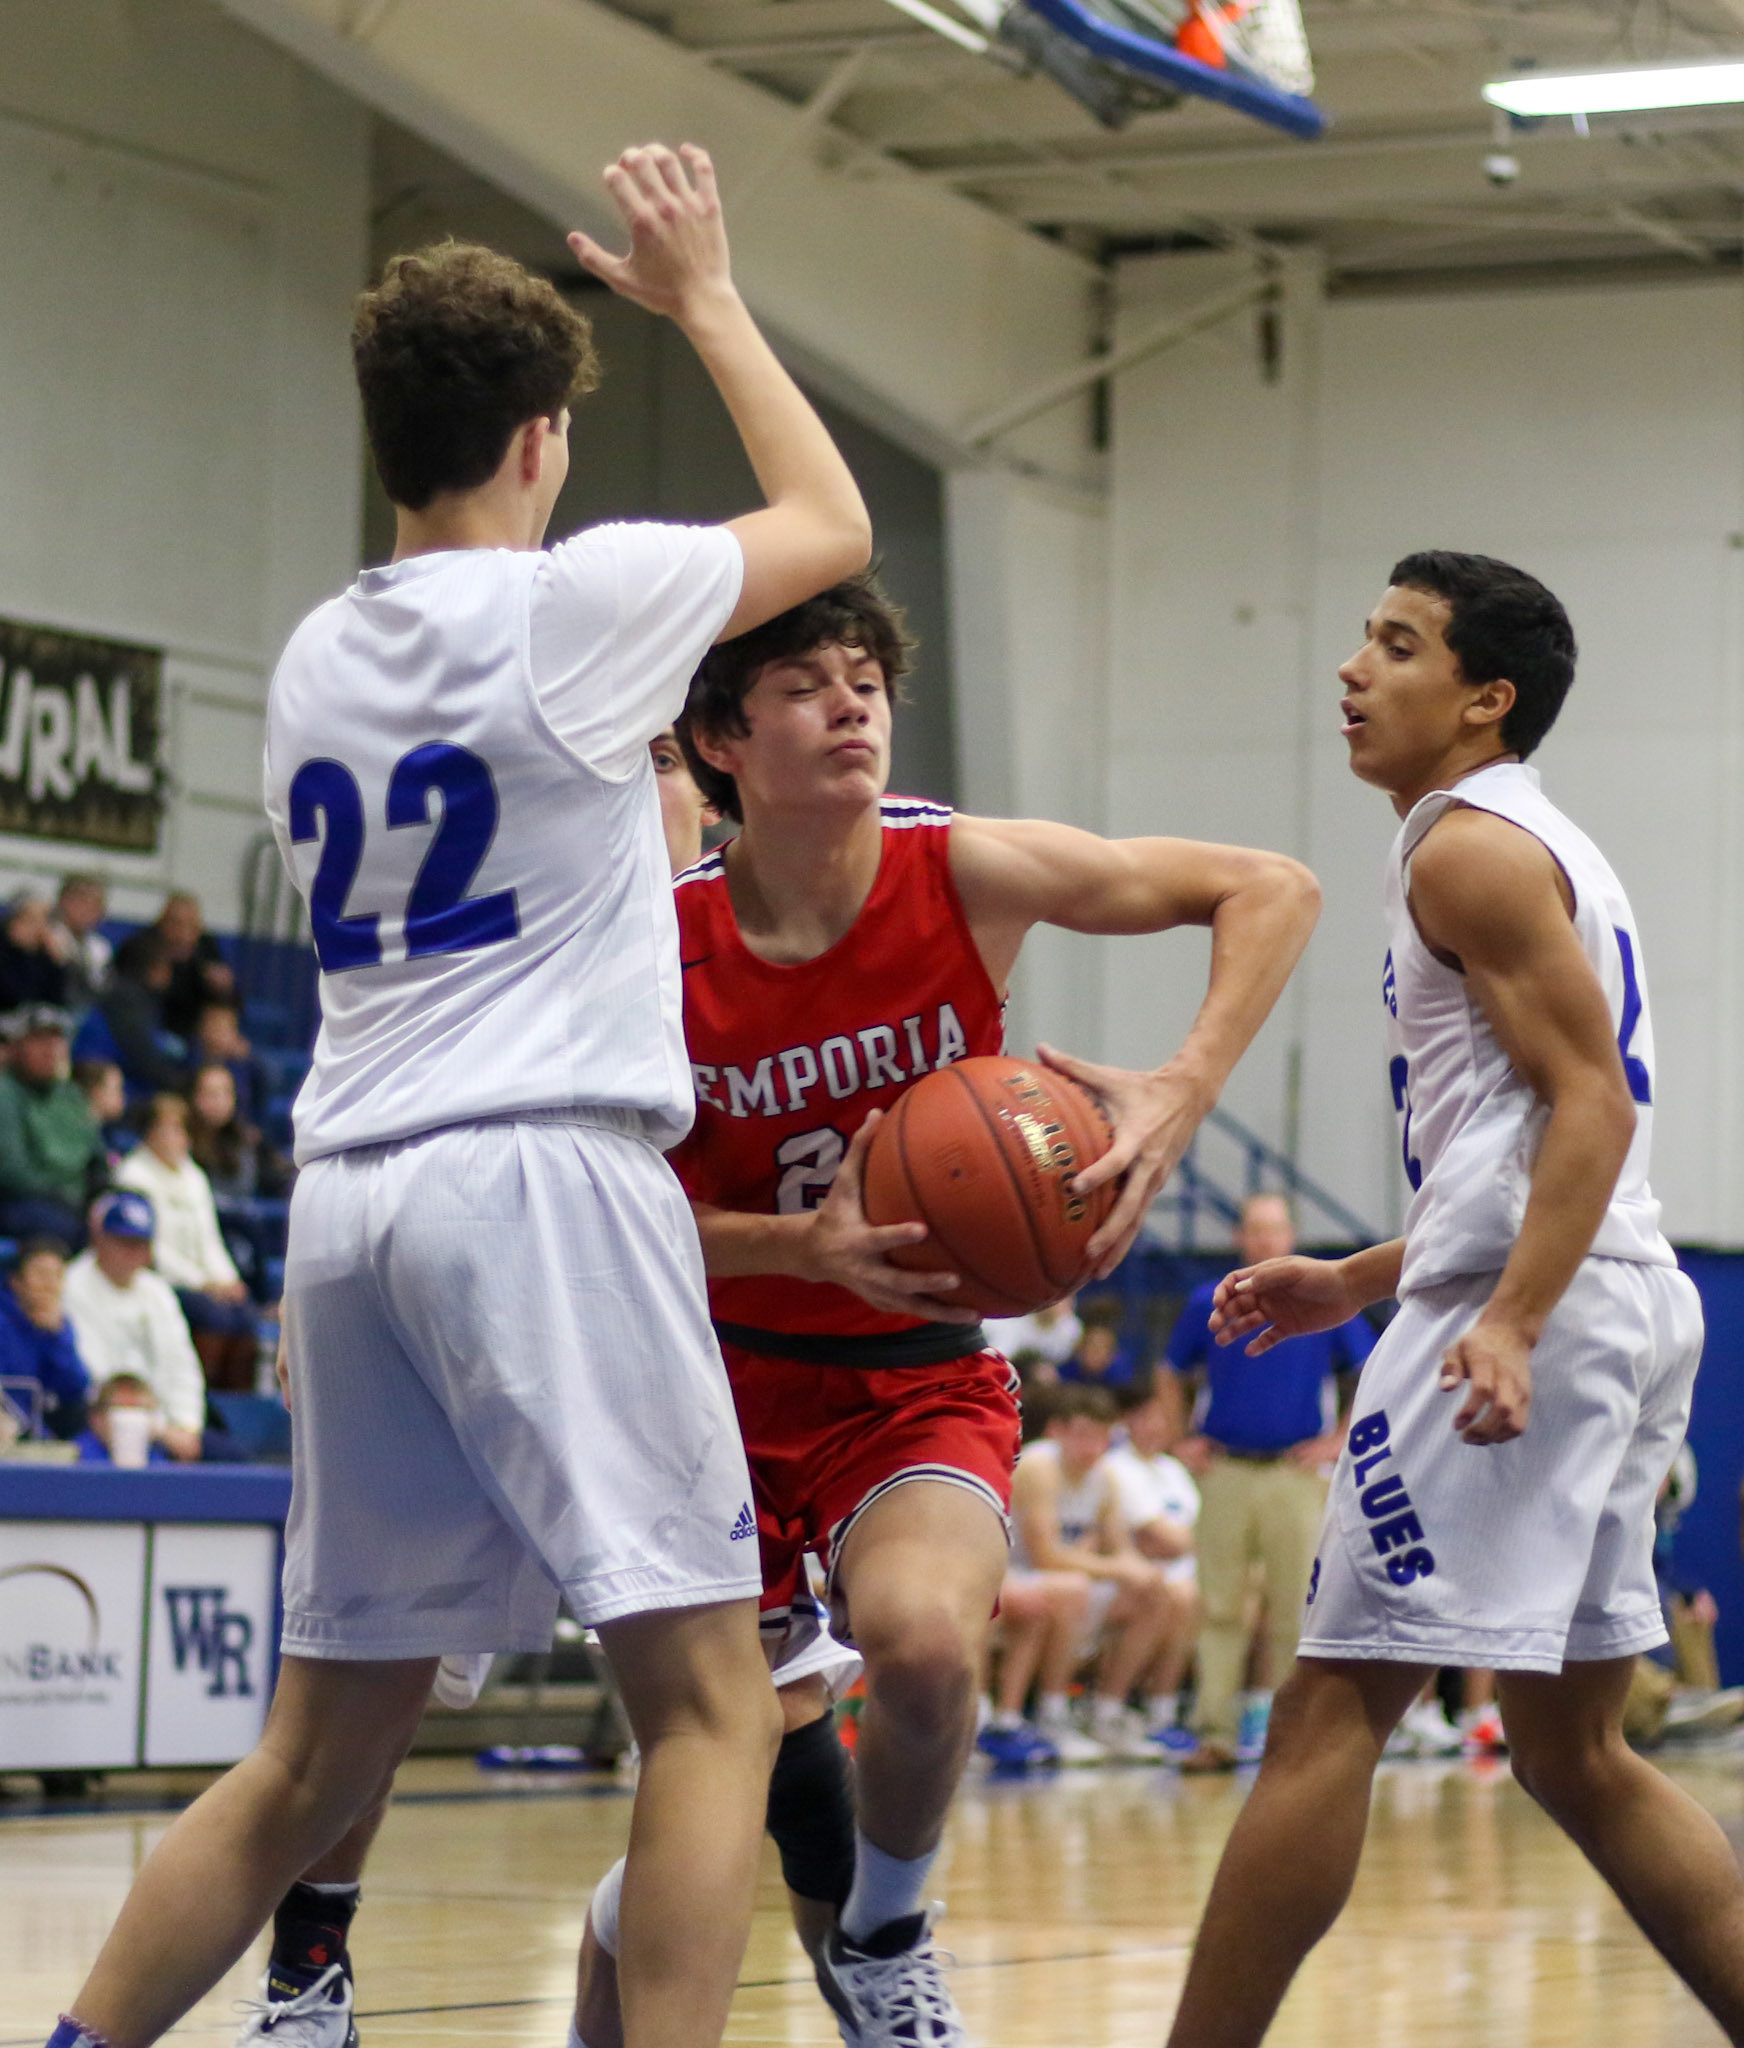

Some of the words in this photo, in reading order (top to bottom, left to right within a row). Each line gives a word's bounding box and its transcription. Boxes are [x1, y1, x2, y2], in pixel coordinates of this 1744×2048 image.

[289, 739, 522, 976] 22
[691, 1002, 967, 1118] EMPORIA
[1349, 1409, 1435, 1586] BLUES
[164, 1586, 254, 1697] WR
